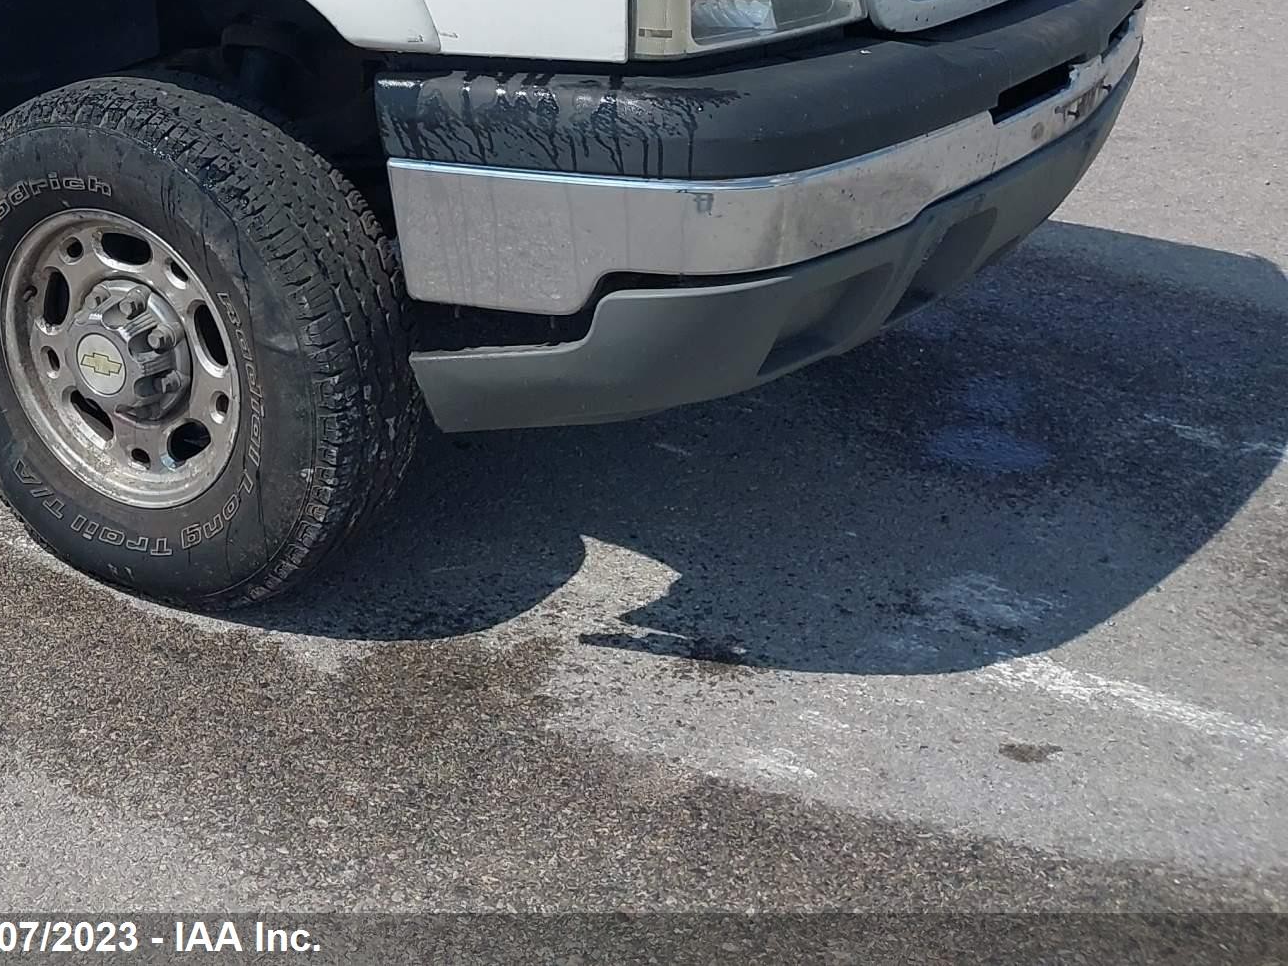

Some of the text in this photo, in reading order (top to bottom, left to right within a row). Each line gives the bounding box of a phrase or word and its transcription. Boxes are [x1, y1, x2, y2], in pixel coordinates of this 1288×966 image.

[13, 292, 265, 556] Radial Long Trail T/A
